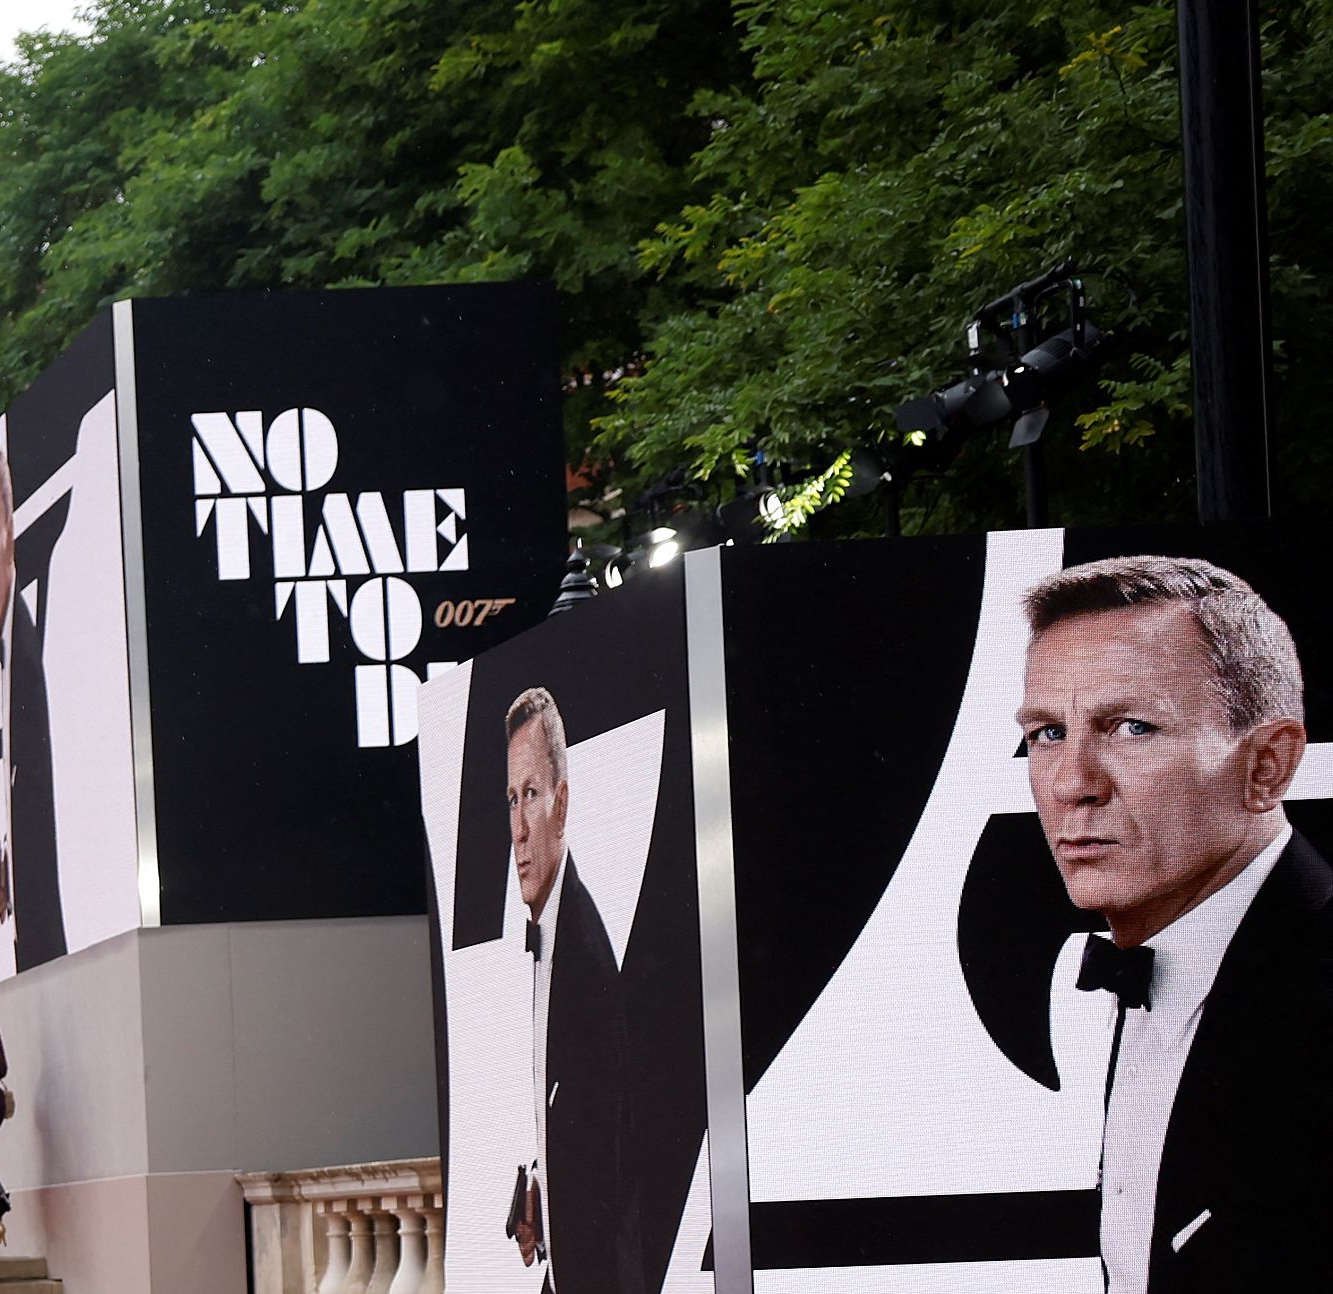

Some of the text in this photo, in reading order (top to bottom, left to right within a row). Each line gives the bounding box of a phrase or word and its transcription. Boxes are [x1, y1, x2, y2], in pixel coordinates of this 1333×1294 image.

[191, 407, 339, 495] NO
[195, 488, 469, 580] TIME
[274, 576, 423, 664] TO
[434, 598, 517, 628] 007
